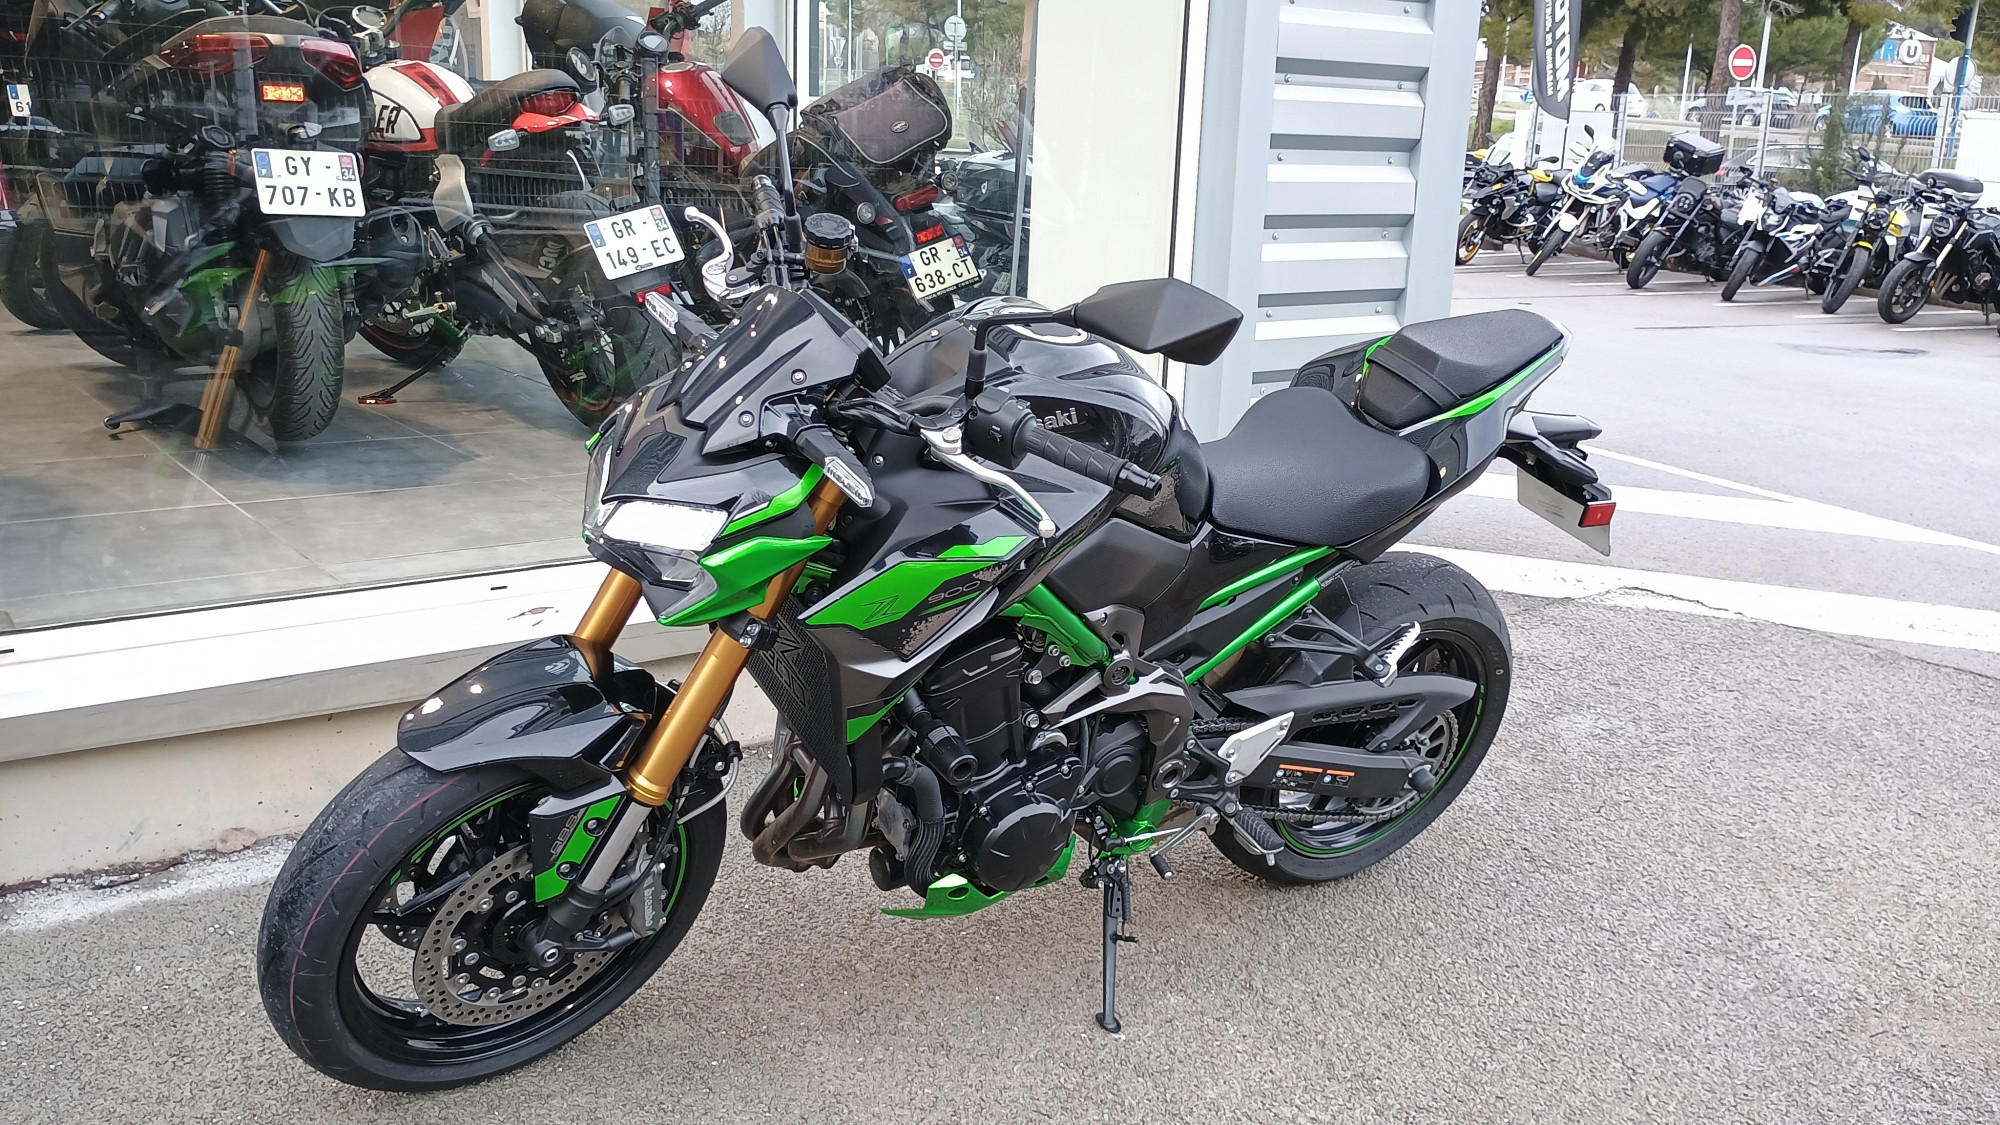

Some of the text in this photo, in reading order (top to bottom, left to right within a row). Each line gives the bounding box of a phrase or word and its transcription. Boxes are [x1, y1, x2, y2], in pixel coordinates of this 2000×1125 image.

[285, 156, 311, 176] GY
[341, 168, 356, 181] 34
[611, 218, 636, 239] GR
[655, 218, 669, 232] 34
[920, 246, 942, 266] GR
[957, 248, 968, 257] 34
[928, 580, 981, 605] 900
[862, 594, 905, 625] Z
[550, 814, 578, 855] ABS
